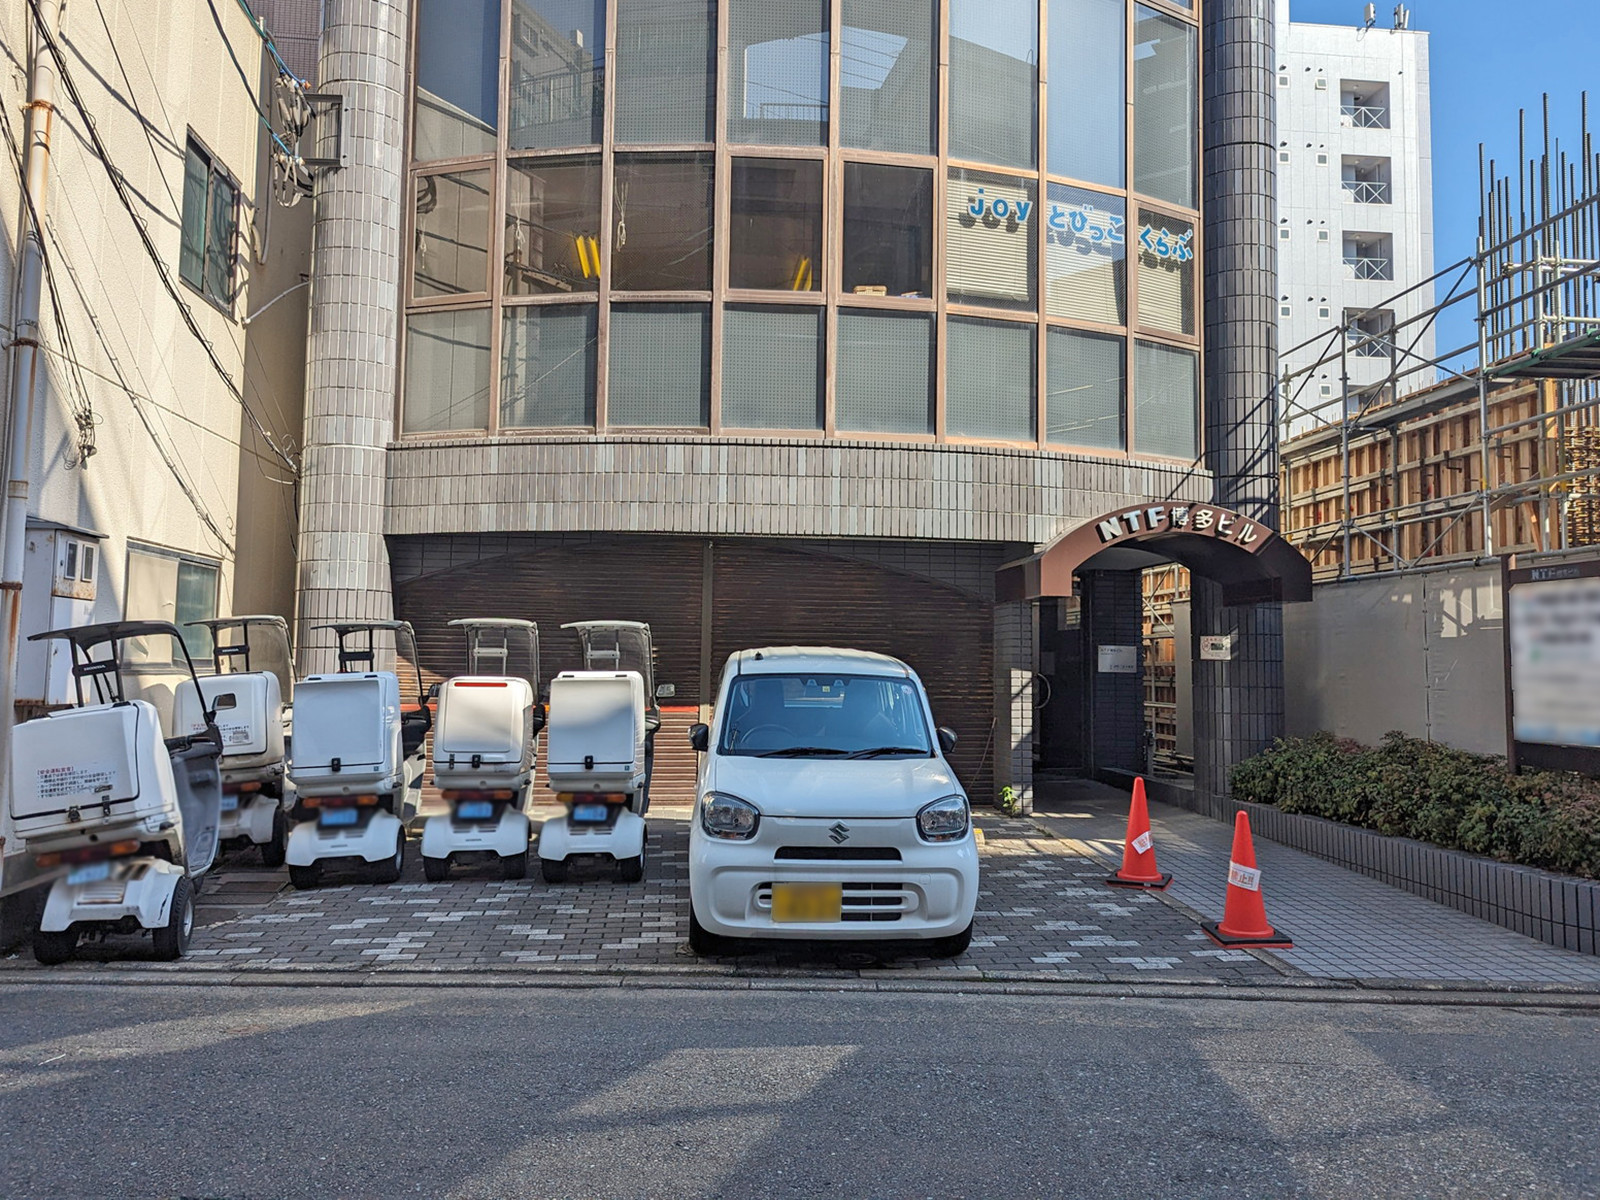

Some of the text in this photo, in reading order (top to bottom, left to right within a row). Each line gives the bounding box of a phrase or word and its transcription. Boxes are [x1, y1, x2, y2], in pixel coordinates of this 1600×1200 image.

[969, 188, 1194, 262] joy とびっこ くらぶ
[1097, 505, 1258, 544] NTF博多ビル
